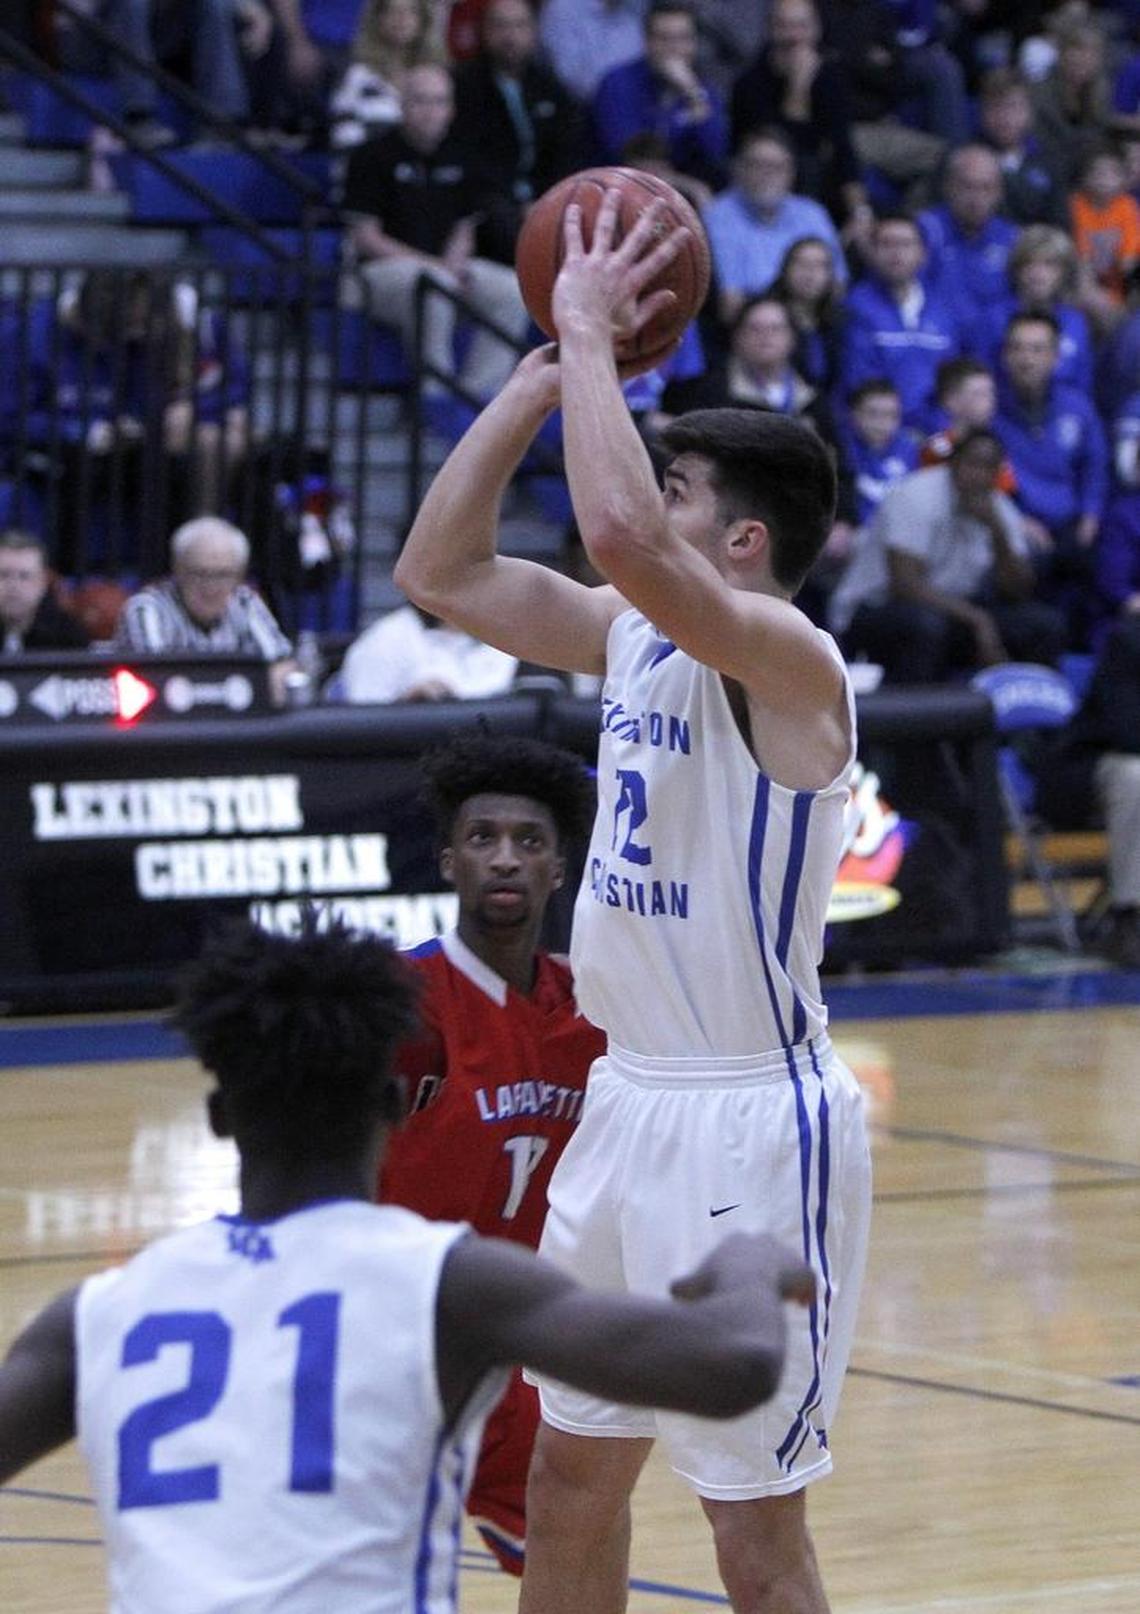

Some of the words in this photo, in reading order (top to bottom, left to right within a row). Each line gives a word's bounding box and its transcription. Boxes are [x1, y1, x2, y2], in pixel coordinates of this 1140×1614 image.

[32, 777, 302, 839] LEXINGTON
[137, 835, 390, 899] CHRISTIAN
[117, 1290, 342, 1511] 21
